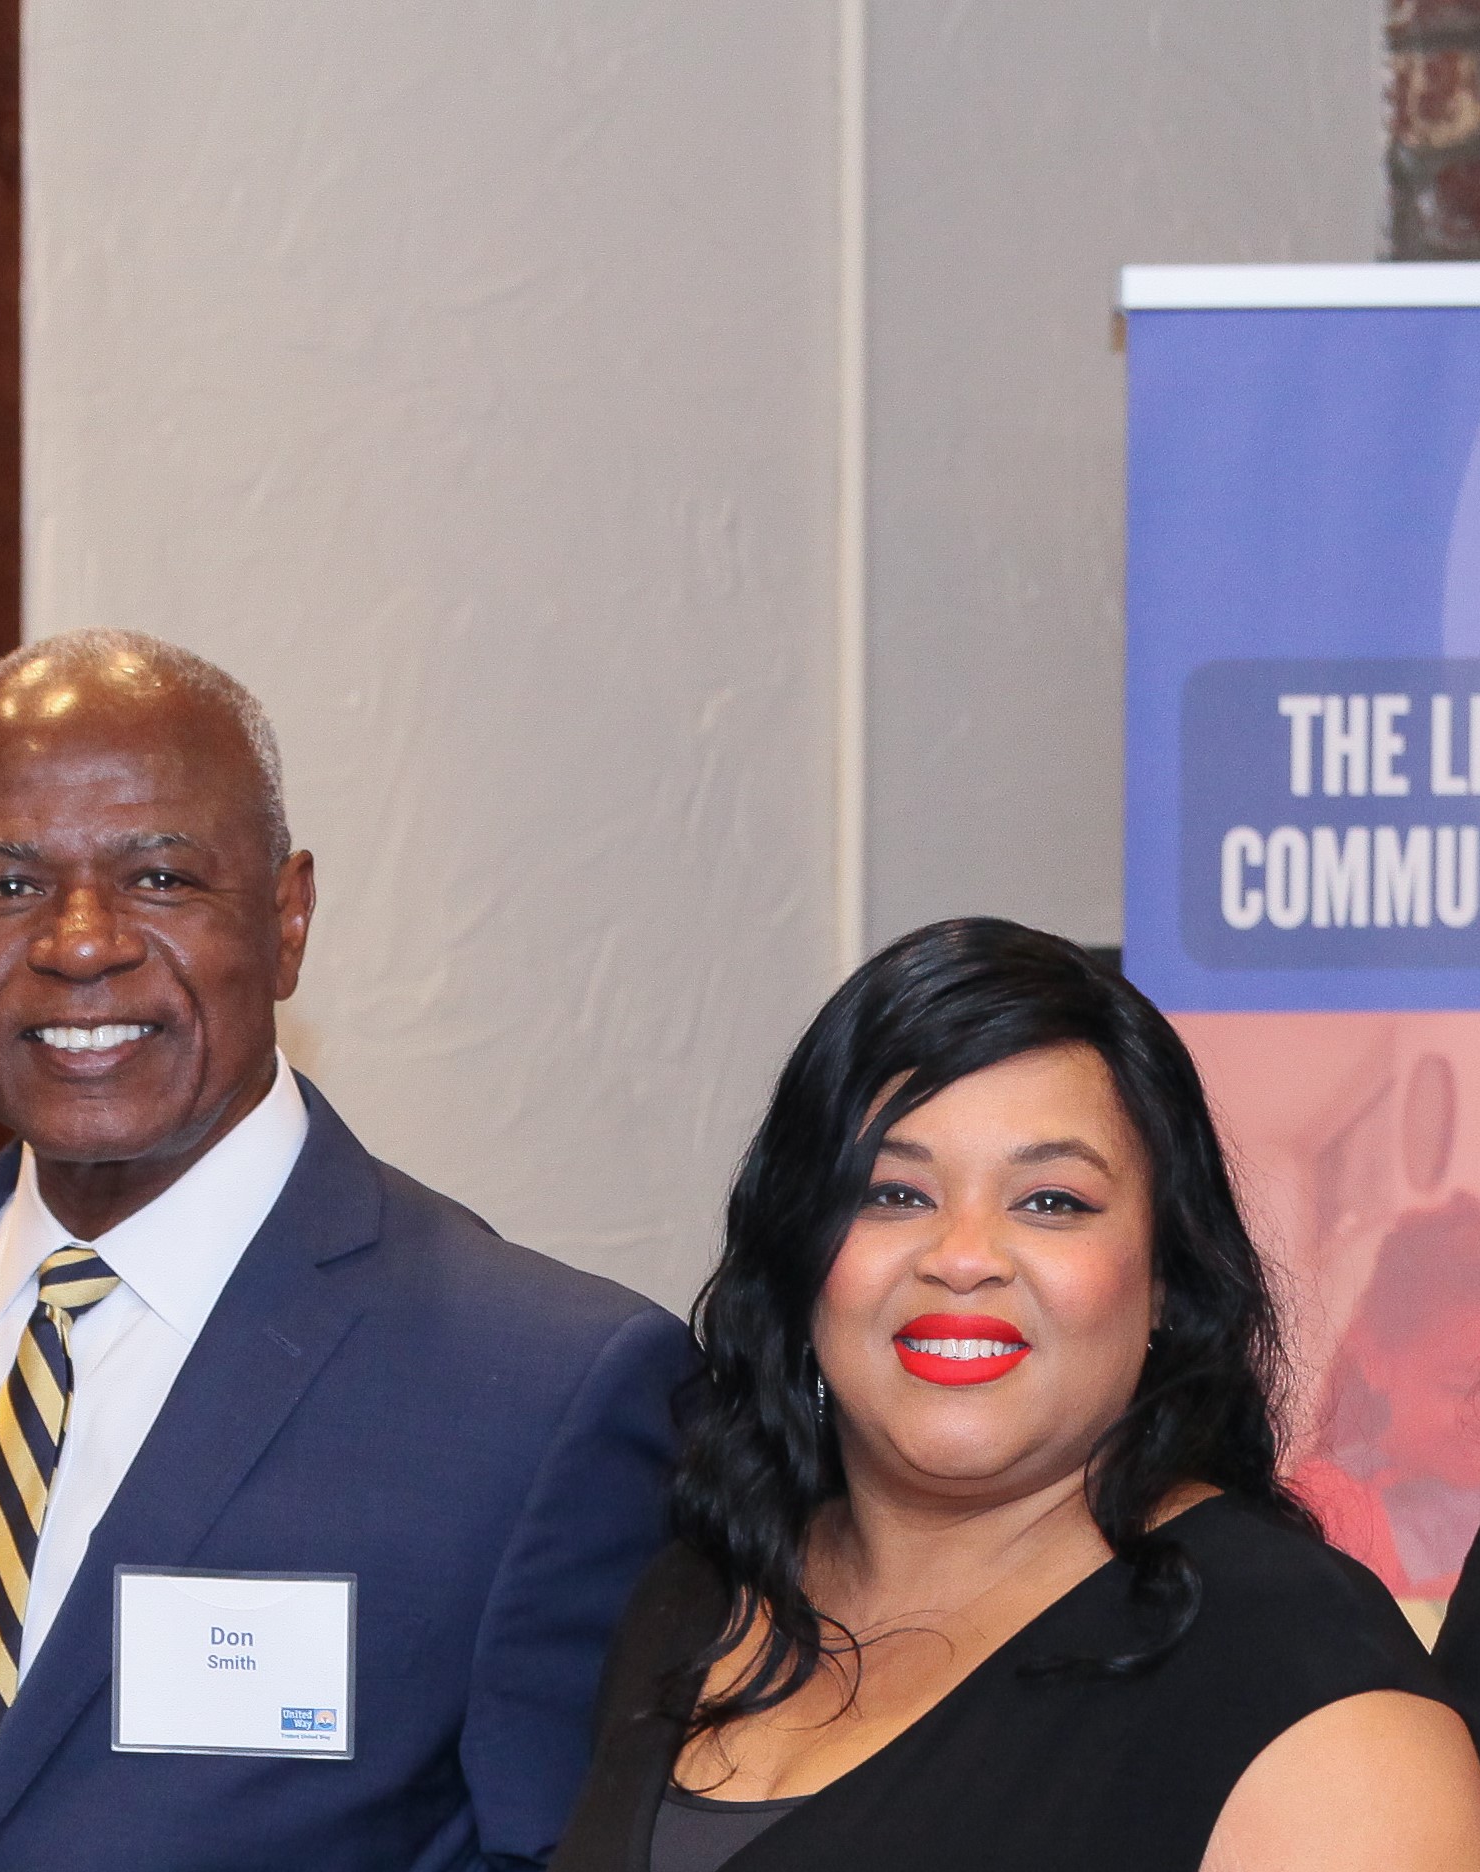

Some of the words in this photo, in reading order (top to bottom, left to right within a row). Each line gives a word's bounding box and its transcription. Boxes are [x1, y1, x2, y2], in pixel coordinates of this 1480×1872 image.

[1278, 693, 1411, 797] THE
[211, 1626, 254, 1647] Don
[207, 1654, 256, 1671] Smith
[282, 1709, 313, 1720] United
